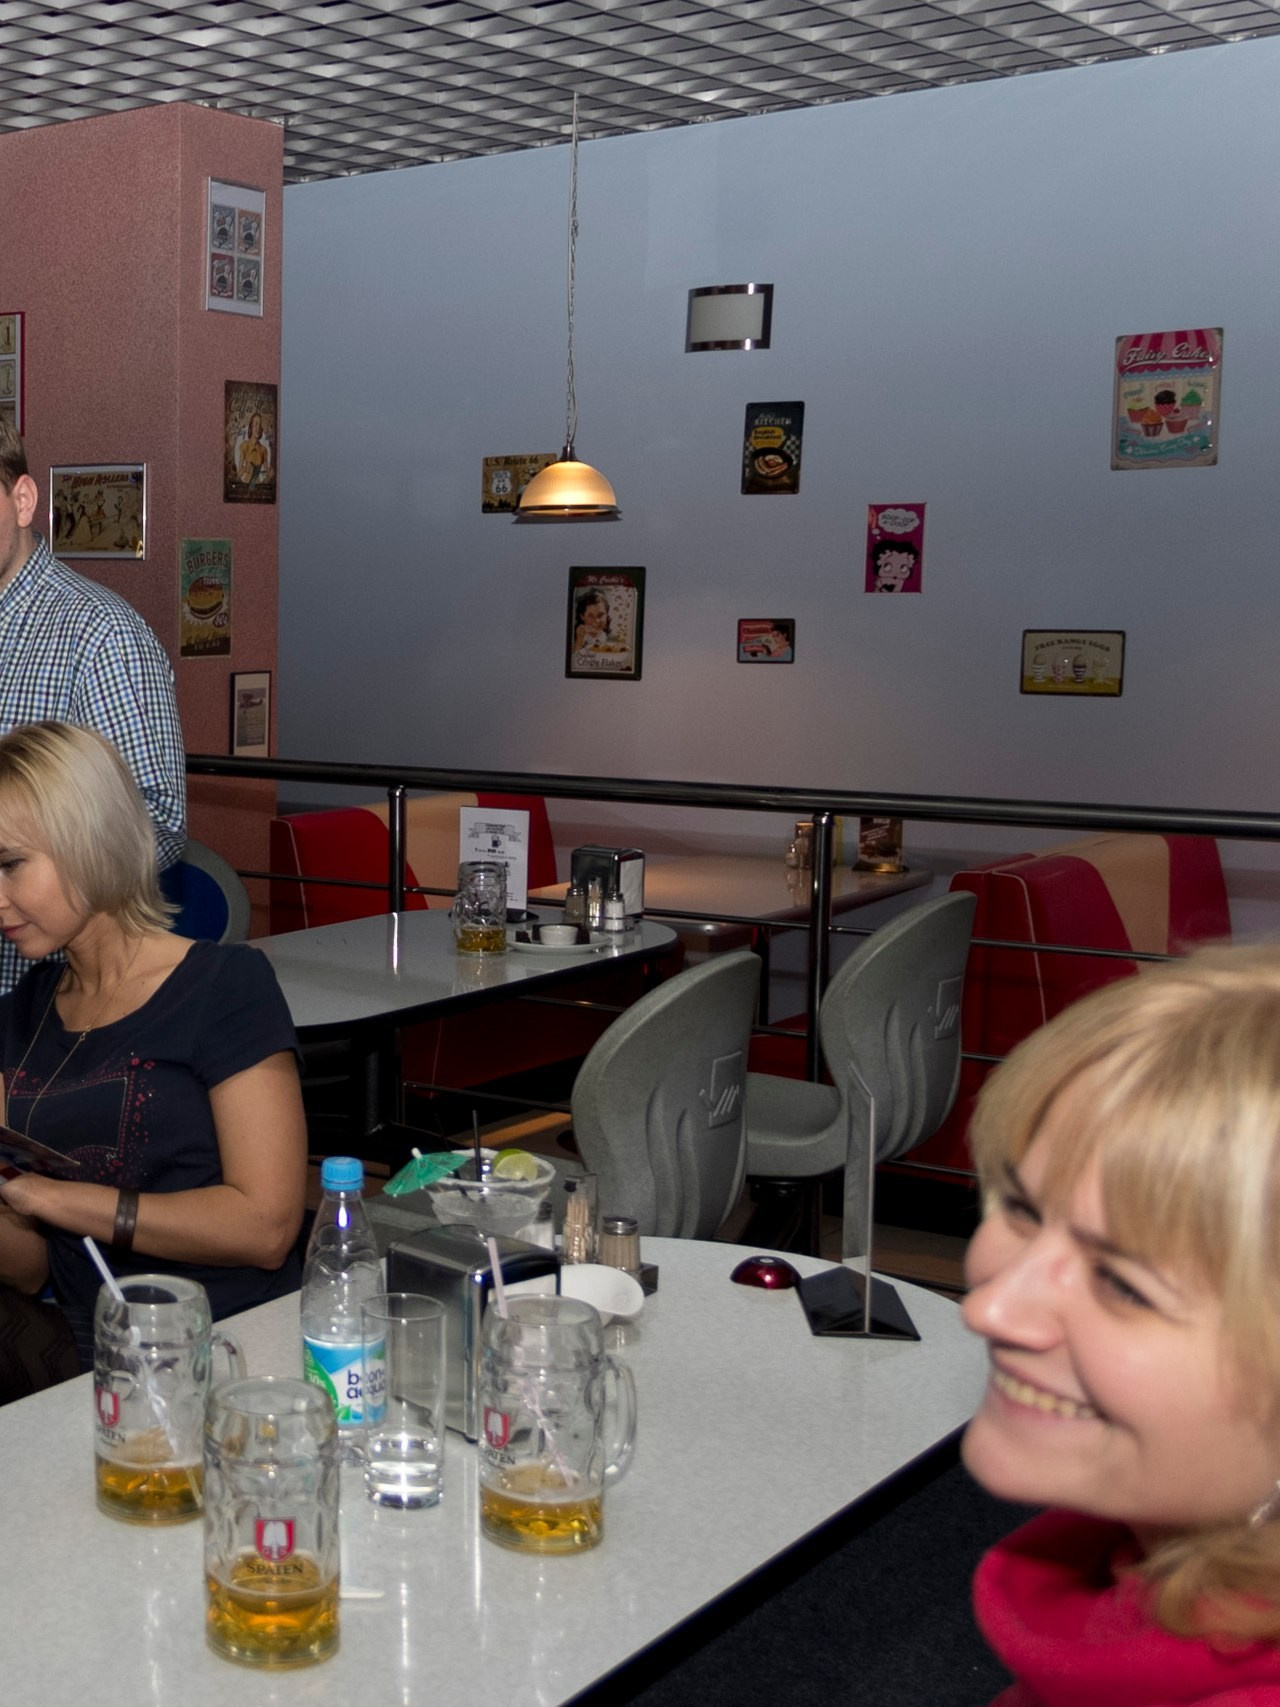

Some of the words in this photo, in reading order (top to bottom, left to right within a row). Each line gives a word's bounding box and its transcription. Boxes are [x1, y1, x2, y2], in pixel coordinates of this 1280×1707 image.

[1122, 346, 1167, 366] Fairy
[1172, 342, 1214, 359] Cakes
[504, 456, 527, 467] Route
[528, 455, 540, 465] 66
[495, 483, 508, 494] 66
[186, 551, 229, 575] BURGERS
[1034, 640, 1055, 651] FREE
[1088, 640, 1111, 652] EGGS
[246, 1562, 304, 1575] SPATEN
